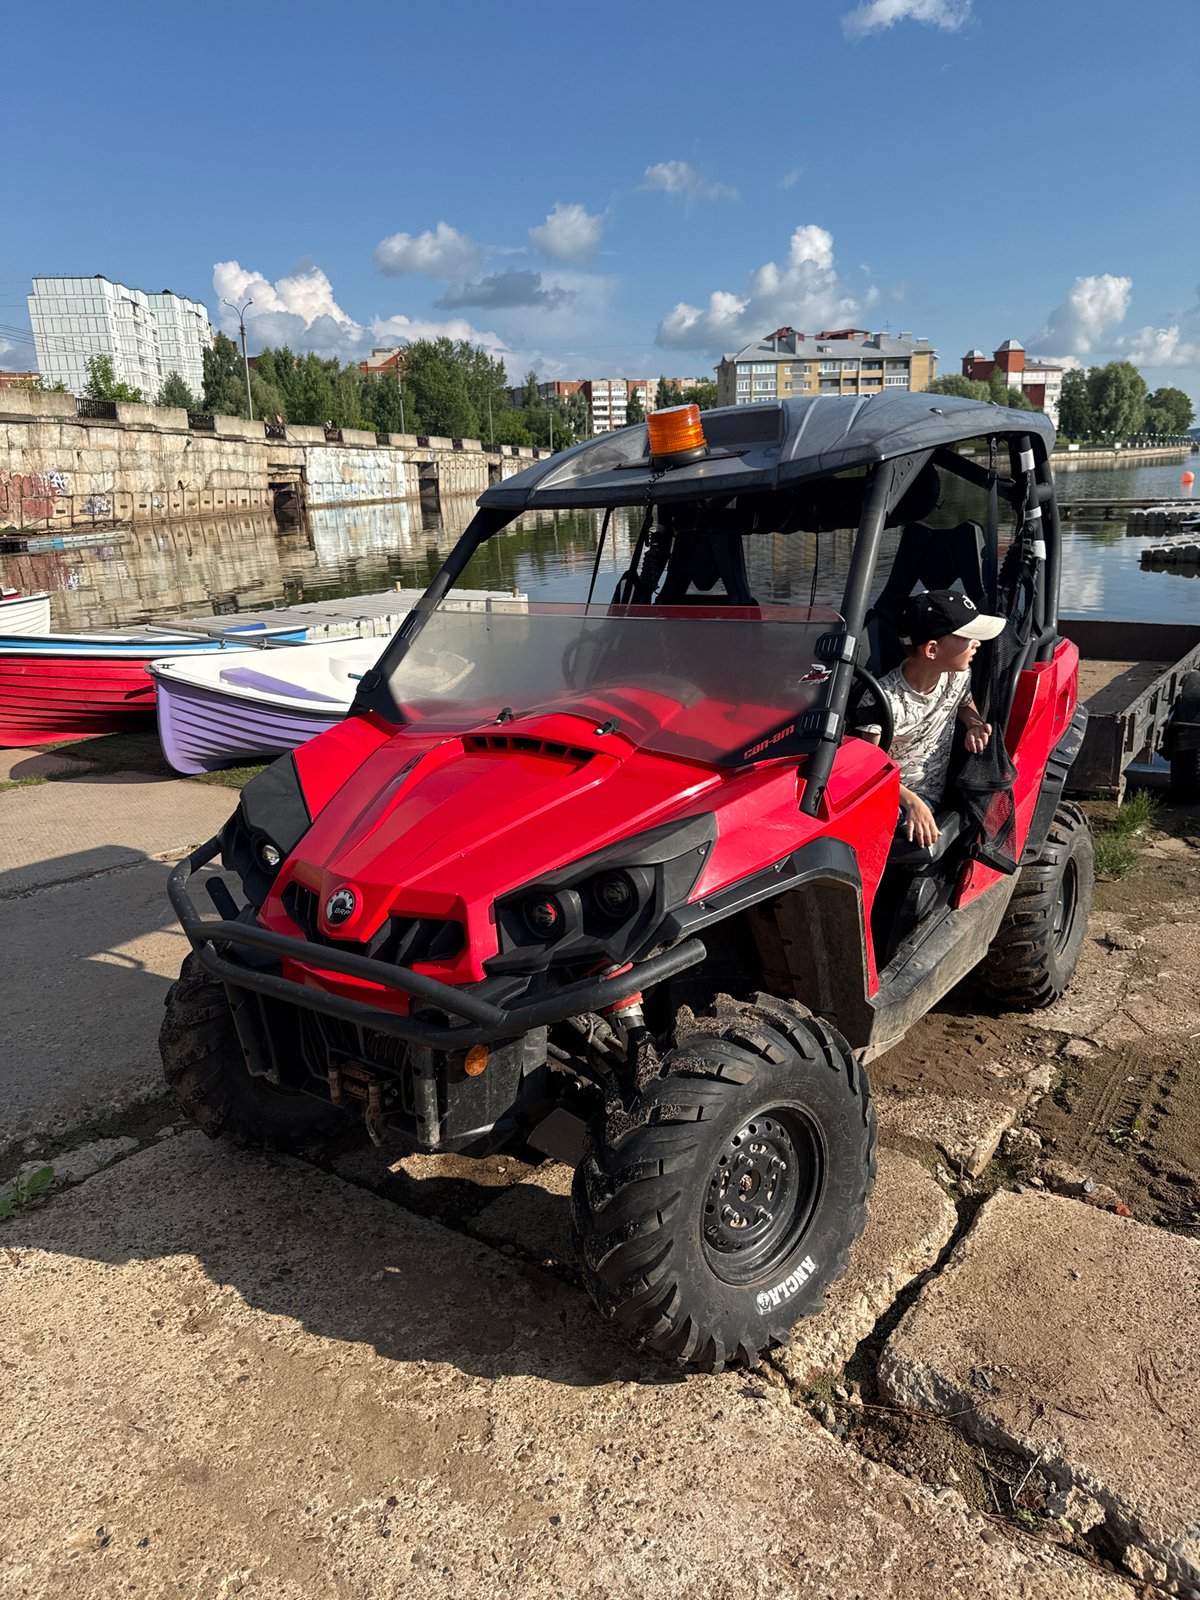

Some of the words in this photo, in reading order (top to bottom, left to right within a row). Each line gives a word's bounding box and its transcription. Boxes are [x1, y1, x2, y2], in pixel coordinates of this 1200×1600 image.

[743, 724, 795, 760] can-am
[334, 907, 351, 916] BRP
[767, 1255, 816, 1306] ANCLA
